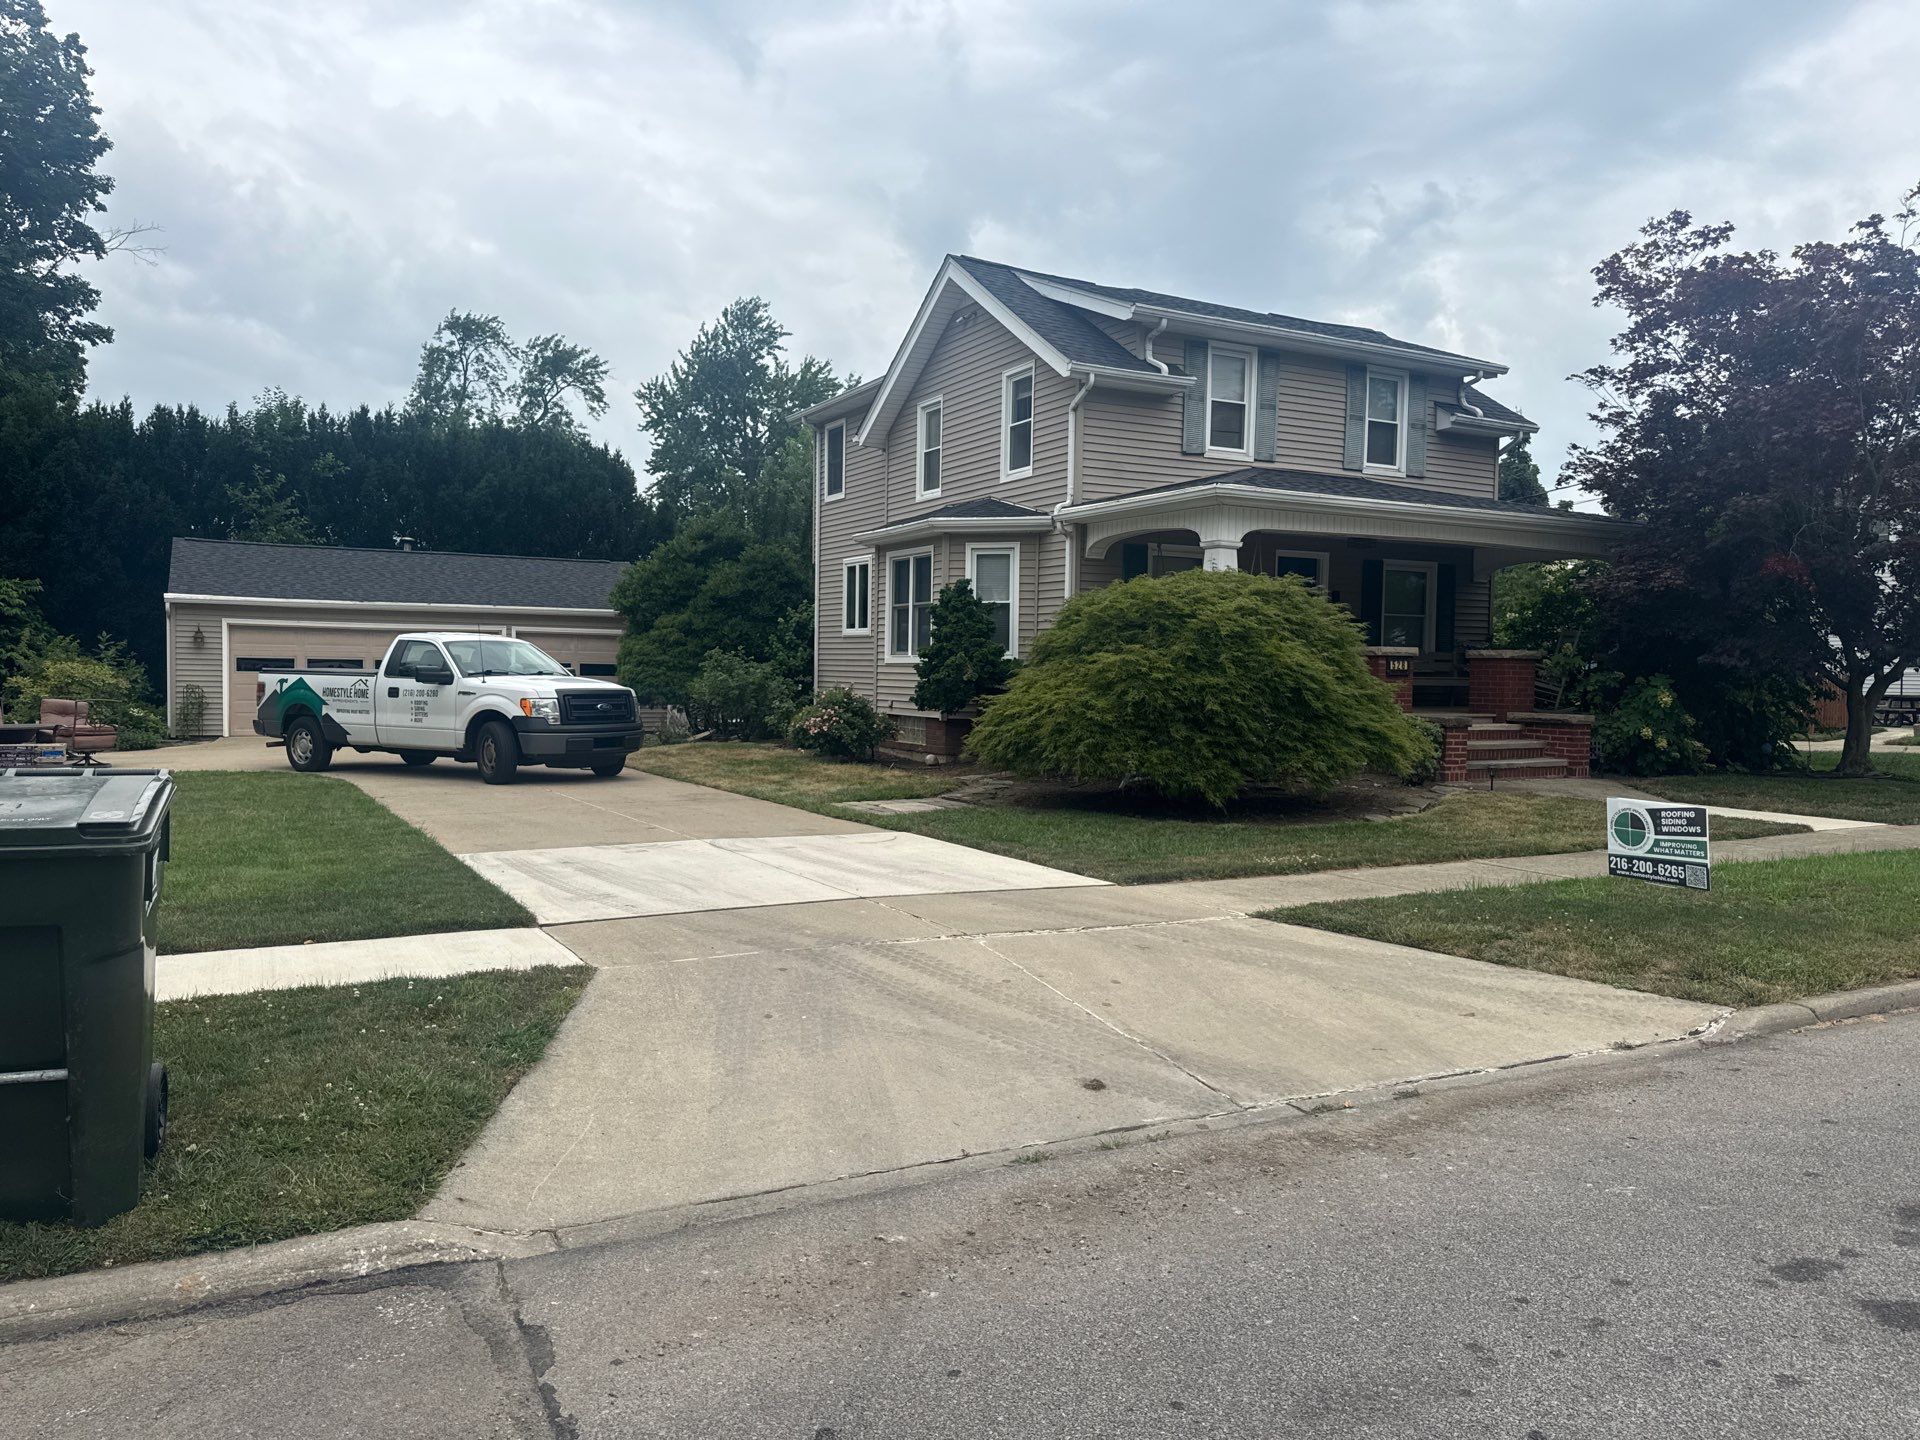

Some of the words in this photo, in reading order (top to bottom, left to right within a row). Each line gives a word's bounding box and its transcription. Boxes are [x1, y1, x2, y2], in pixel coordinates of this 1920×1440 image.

[322, 687, 352, 698] HOMESTYLE
[353, 687, 369, 699] HOME
[1659, 841, 1697, 849] IMPROVING
[1674, 849, 1705, 857] MATTERS
[1610, 856, 1685, 879] 216-200-6265
